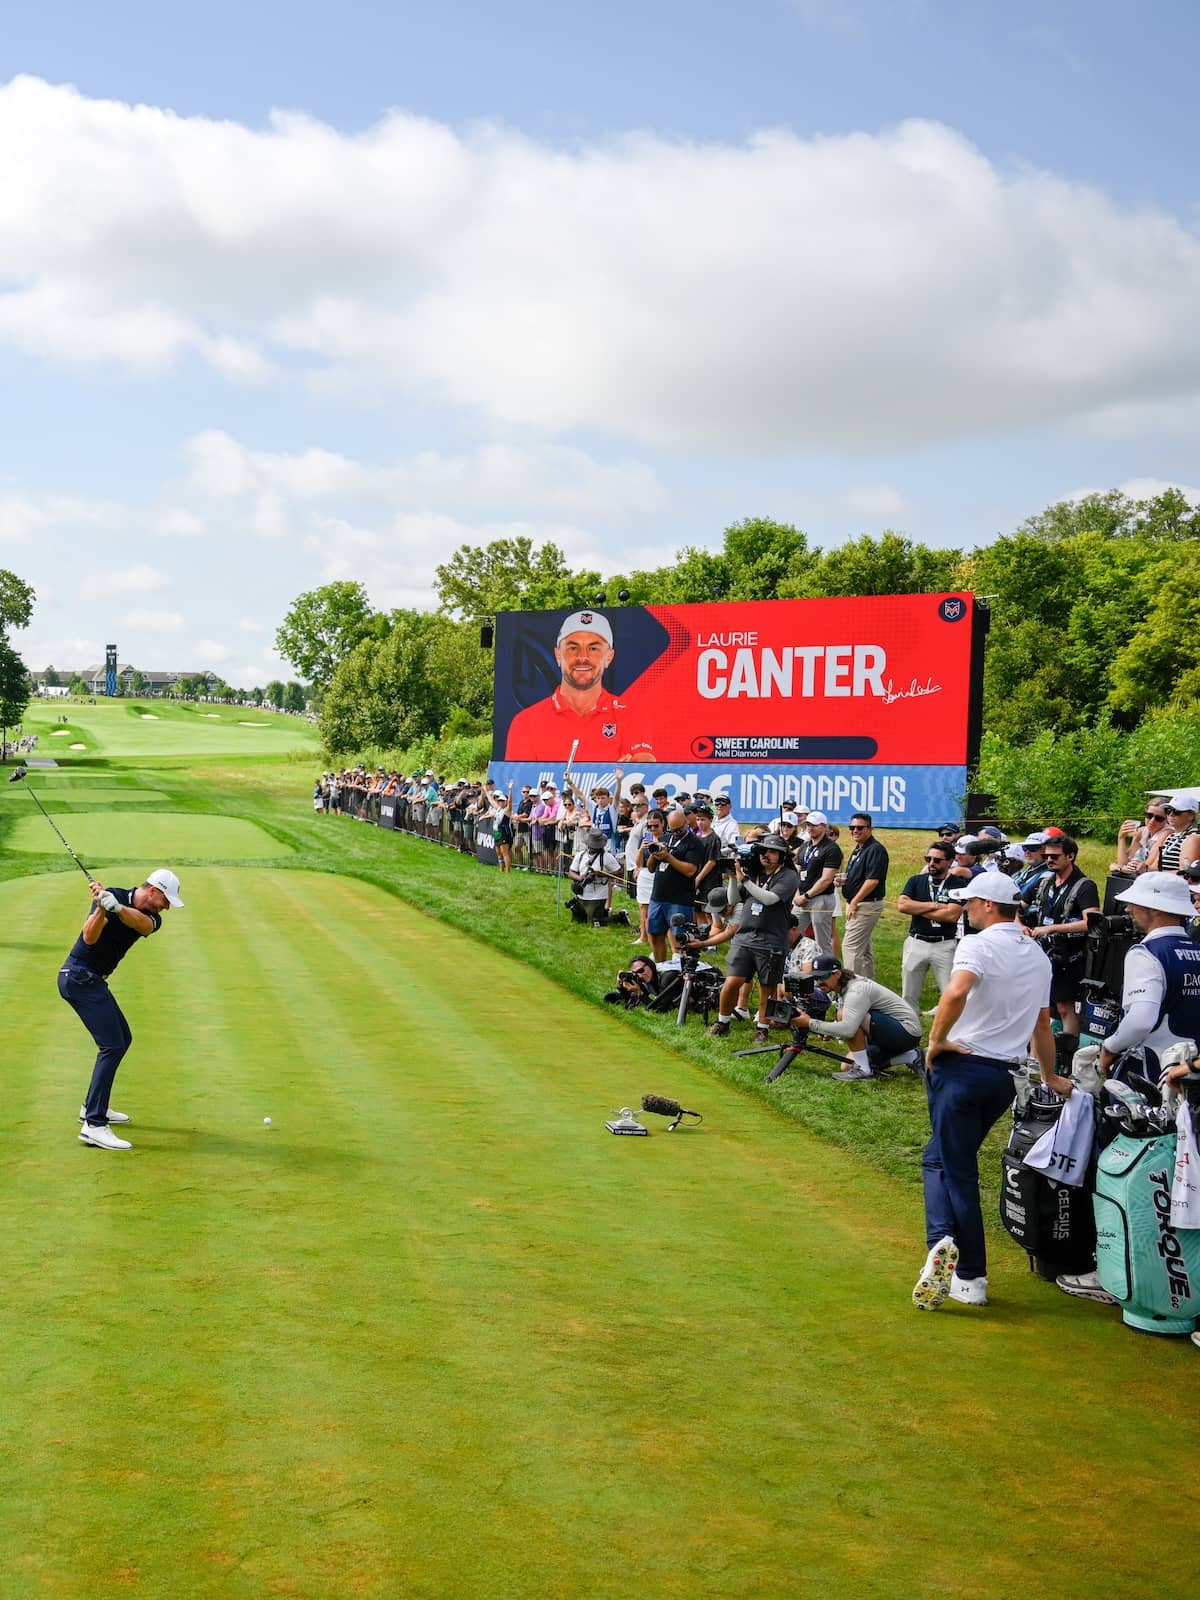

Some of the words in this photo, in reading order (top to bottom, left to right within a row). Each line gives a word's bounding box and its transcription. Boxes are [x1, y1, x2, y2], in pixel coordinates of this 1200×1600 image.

[697, 631, 758, 647] LAURIE
[697, 644, 887, 699] CANTER
[714, 750, 730, 758] Neil
[731, 750, 768, 758] Diamond
[715, 738, 748, 750] SWEET
[750, 738, 799, 750] CAROLINE
[740, 774, 906, 812] INDIANAPOLIS
[1058, 1189, 1070, 1240] CELSIUS
[1148, 1168, 1191, 1299] TORQUE
